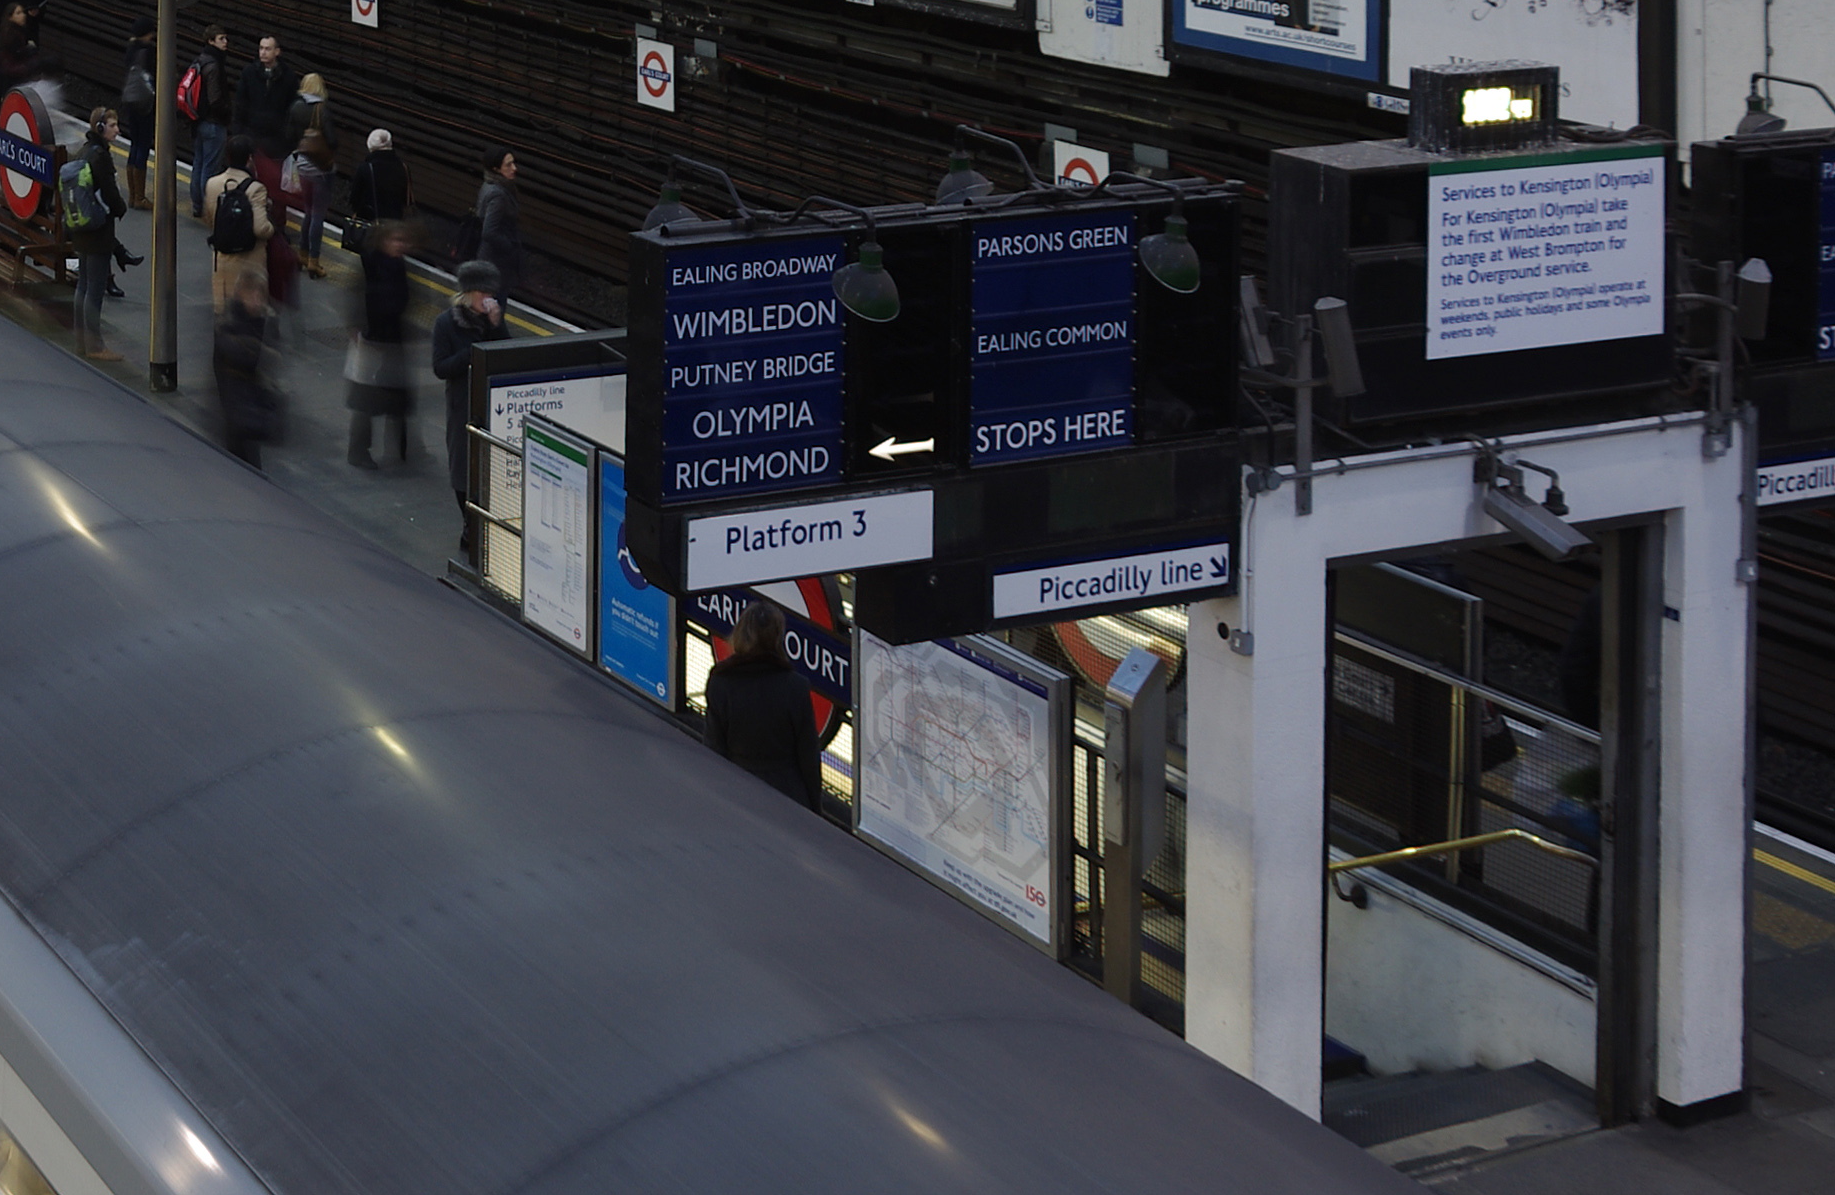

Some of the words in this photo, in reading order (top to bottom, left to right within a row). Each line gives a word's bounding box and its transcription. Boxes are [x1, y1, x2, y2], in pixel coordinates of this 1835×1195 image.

[1245, 26, 1356, 51] www.arts.ac.uk/shortcourses
[18, 148, 46, 174] COURT
[1442, 185, 1496, 202] Services
[1500, 183, 1516, 197] to
[1520, 177, 1591, 195] Kensington
[1594, 168, 1654, 190] (Olympia)
[1442, 212, 1462, 227] For
[1466, 205, 1536, 225] Kensington
[1540, 198, 1598, 219] (Olympia)
[1602, 198, 1628, 212] take
[978, 232, 1064, 258] PARSONS
[1069, 226, 1128, 250] GREEN
[1442, 232, 1464, 246] the
[1468, 229, 1494, 244] first
[1499, 222, 1570, 241] Wimbledon
[1574, 219, 1602, 234] train
[1606, 216, 1628, 231] and
[1442, 250, 1486, 268] change
[1490, 248, 1504, 262] at
[1508, 245, 1540, 260] West
[1544, 238, 1606, 258] Brompton
[1608, 236, 1626, 250] for
[672, 264, 738, 286] EALING
[742, 254, 837, 280] BROADWAY
[1442, 272, 1464, 287] the
[1468, 264, 1542, 284] Overground
[1545, 260, 1592, 279] service.
[1441, 297, 1480, 310] Services
[1483, 296, 1494, 307] to
[1497, 290, 1550, 304] Kensington
[1552, 284, 1596, 299] (Olympia)
[1598, 282, 1634, 295] operate
[1636, 280, 1646, 290] at
[1494, 306, 1522, 322] public
[1526, 302, 1564, 318] holidays
[1566, 300, 1583, 312] and
[1586, 298, 1610, 310] some
[1614, 293, 1652, 308] Olympia
[673, 299, 836, 340] WIMBLEDON
[1440, 328, 1472, 340] events
[978, 330, 1042, 354] EALING
[1046, 321, 1127, 346] COMMON
[672, 360, 757, 388] PUTNEY
[764, 352, 836, 380] BRIDGE
[507, 387, 546, 399] Piccadilly
[550, 386, 565, 395] line
[507, 400, 564, 414] Platforms
[507, 418, 514, 429] 5
[693, 400, 814, 439] OLYMPIA
[976, 418, 1056, 453] STOPS
[1064, 409, 1126, 442] HERE
[676, 446, 829, 490] RICHMOND
[726, 517, 842, 555] Platform
[852, 510, 868, 538] 3
[1039, 563, 1151, 605] Piccadilly
[1161, 558, 1204, 588] line
[785, 630, 849, 686] OURT
